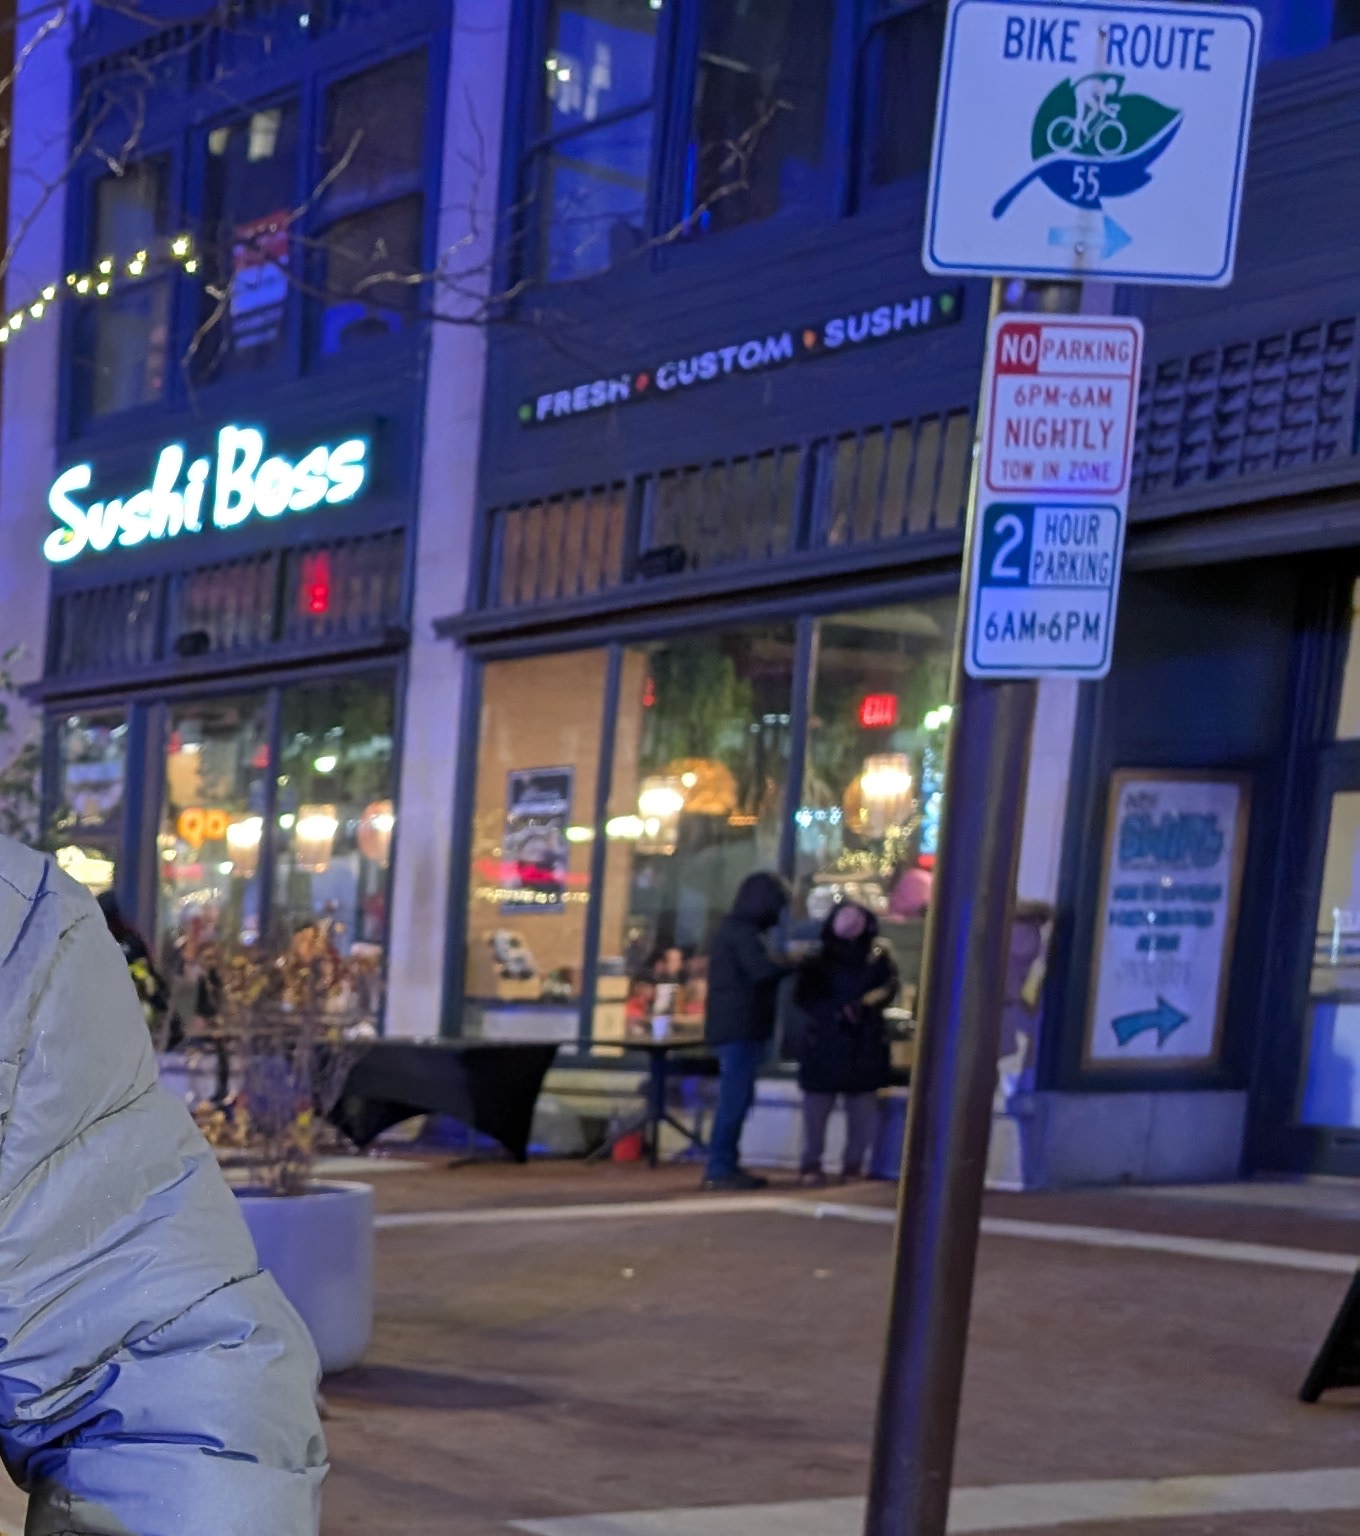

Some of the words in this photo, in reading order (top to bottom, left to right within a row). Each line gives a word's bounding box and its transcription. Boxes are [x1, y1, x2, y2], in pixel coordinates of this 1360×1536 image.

[1003, 15, 1080, 63] BIKE
[1105, 23, 1215, 72] ROUTE
[1070, 165, 1100, 201] 55
[535, 372, 631, 421] FRESH
[655, 331, 794, 391] CUSTOM
[823, 295, 932, 349] SUSHI
[1000, 333, 1037, 366] NO
[1042, 338, 1129, 363] PARKING
[1004, 417, 1114, 450] NIGHTLY
[1001, 460, 1034, 481] TOW
[1042, 461, 1060, 481] IN
[1068, 461, 1110, 483] ZONE
[43, 443, 210, 563] Sushi
[213, 424, 366, 529] Boss
[991, 513, 1024, 578] 2
[1044, 512, 1101, 547] HOUR
[1032, 551, 1110, 582] PARKING
